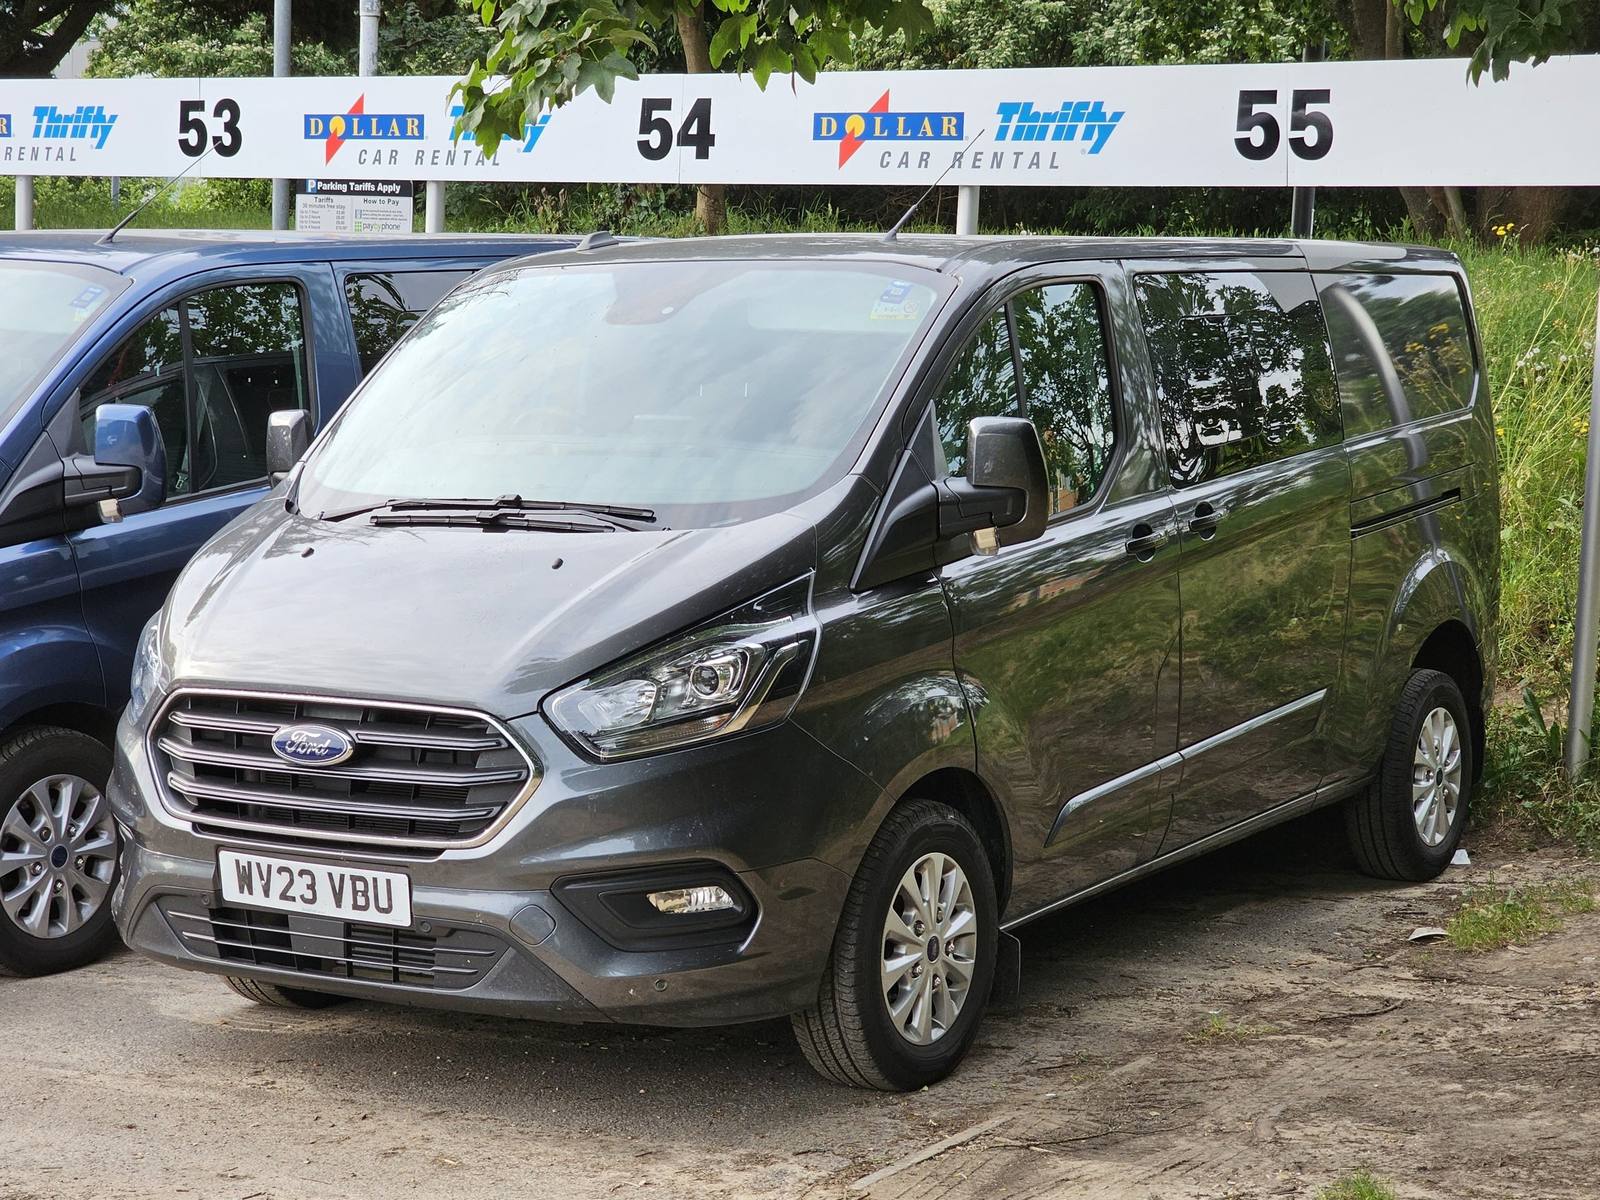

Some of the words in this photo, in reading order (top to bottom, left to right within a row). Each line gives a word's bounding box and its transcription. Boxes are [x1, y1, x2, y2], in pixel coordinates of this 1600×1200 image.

[32, 105, 119, 149] Thrifty
[178, 98, 242, 157] 53
[308, 115, 421, 138] DOLLAR
[636, 98, 715, 161] 54
[819, 114, 959, 138] DOLLAR
[994, 101, 1126, 154] Thrifty
[1234, 89, 1334, 161] 55
[4, 146, 77, 162] RENTAL
[358, 149, 398, 165] CAR
[415, 149, 500, 166] RENTAL
[879, 151, 931, 169] CAR
[952, 151, 1060, 170] RENTAL
[317, 181, 348, 192] Parking
[349, 182, 376, 192] Tariffs
[377, 183, 401, 194] Apply
[363, 222, 401, 232] paybyphone
[285, 730, 332, 757] Ford
[234, 858, 318, 905] WV23
[327, 871, 394, 915] VBU
